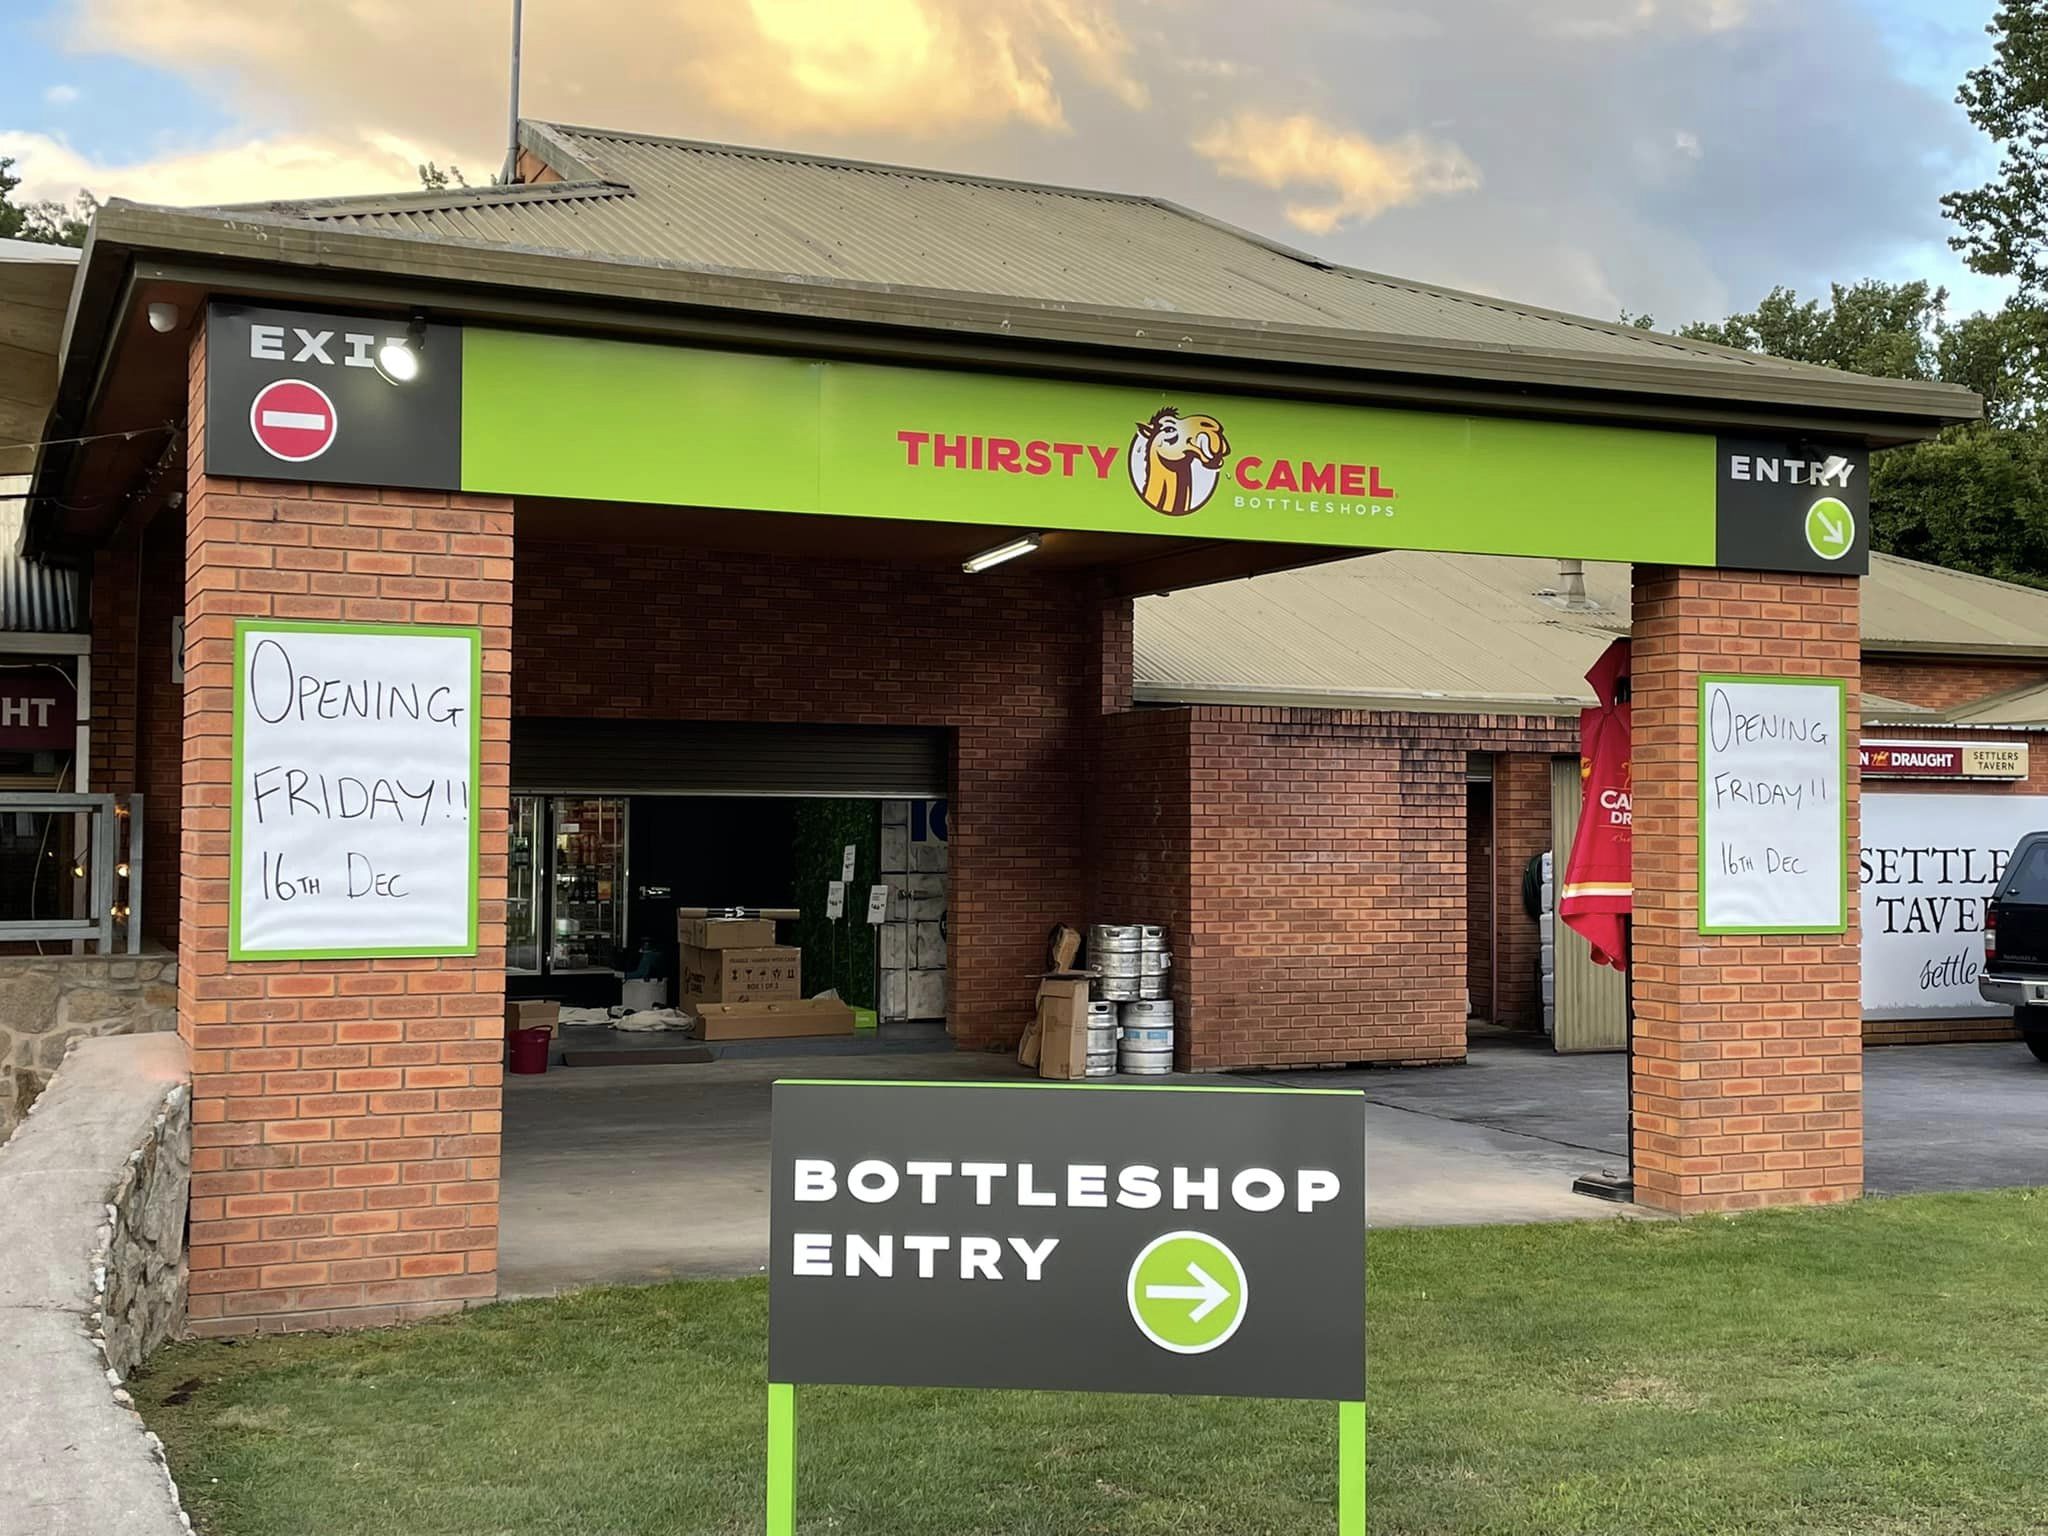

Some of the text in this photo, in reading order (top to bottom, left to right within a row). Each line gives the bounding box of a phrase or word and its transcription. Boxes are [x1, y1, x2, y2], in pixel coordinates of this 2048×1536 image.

[250, 324, 408, 368] EXI
[897, 430, 1395, 499] THIRSTY CAMEL
[1730, 455, 1856, 489] ENTRY
[1234, 496, 1395, 518] BOTTLESHOPS
[1891, 753, 1954, 768] DRAUGHT
[1973, 751, 2019, 761] SETTLERS
[1978, 761, 2015, 771] TAVERN
[1919, 946, 1978, 990] settle
[792, 1158, 1341, 1213] BOTTLESHOP
[792, 1232, 1060, 1282] ENTRY
